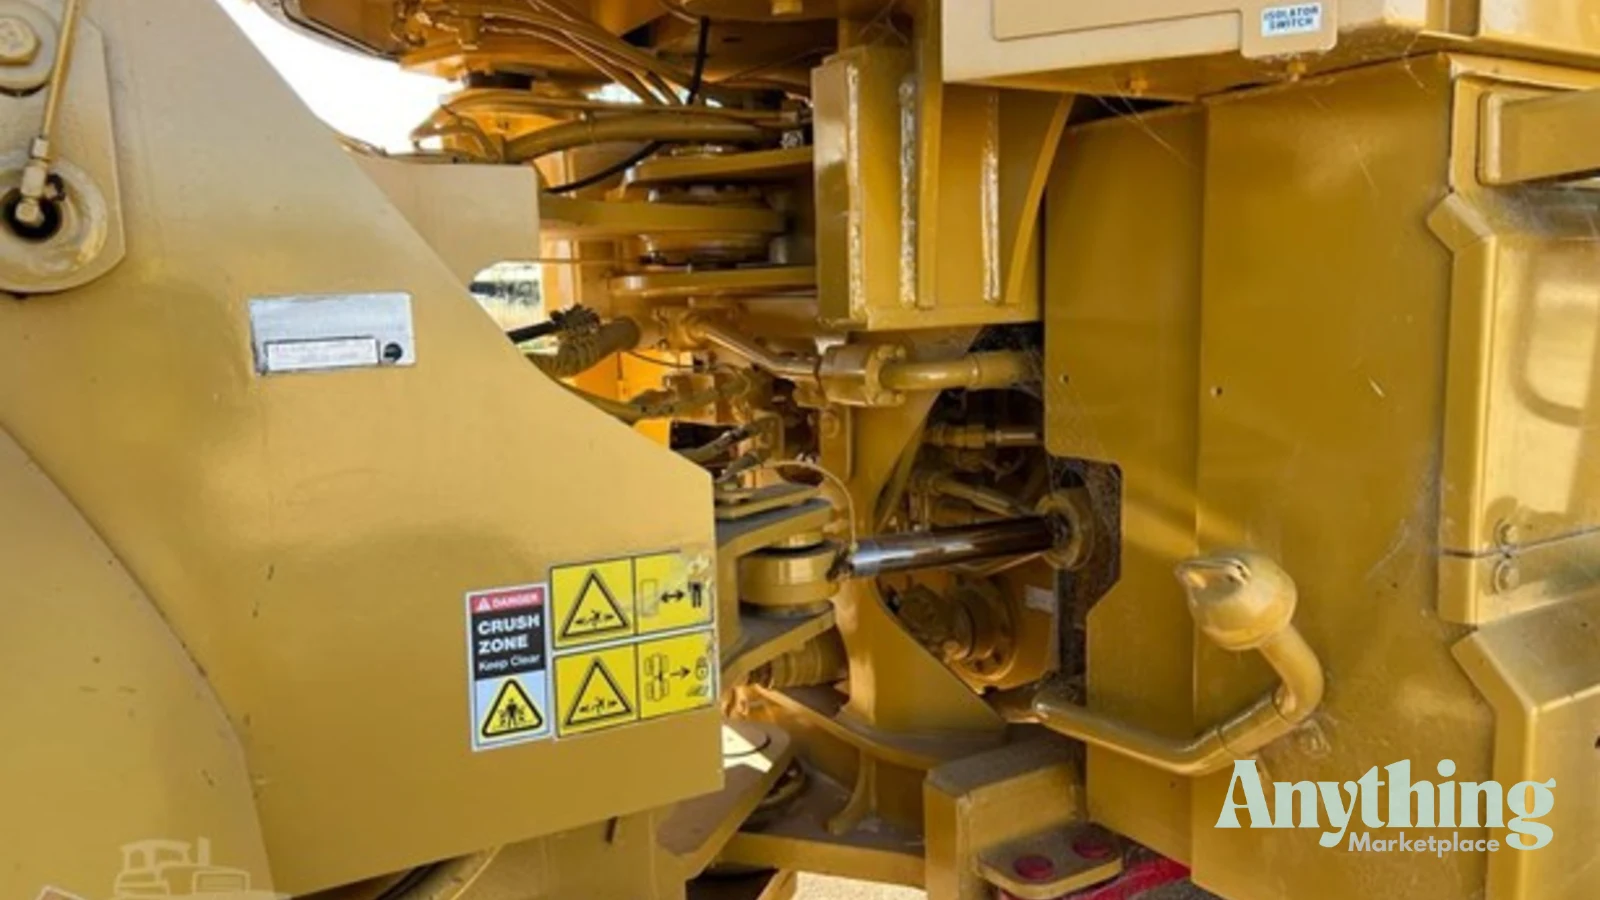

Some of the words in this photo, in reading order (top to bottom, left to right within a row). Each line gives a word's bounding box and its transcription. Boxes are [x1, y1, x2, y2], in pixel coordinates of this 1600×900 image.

[1268, 17, 1313, 30] SWITCH
[492, 592, 538, 608] DANGER
[477, 613, 541, 635] CRUSH
[478, 635, 529, 655] ZONE
[478, 658, 508, 673] Keep
[510, 653, 541, 667] Clear
